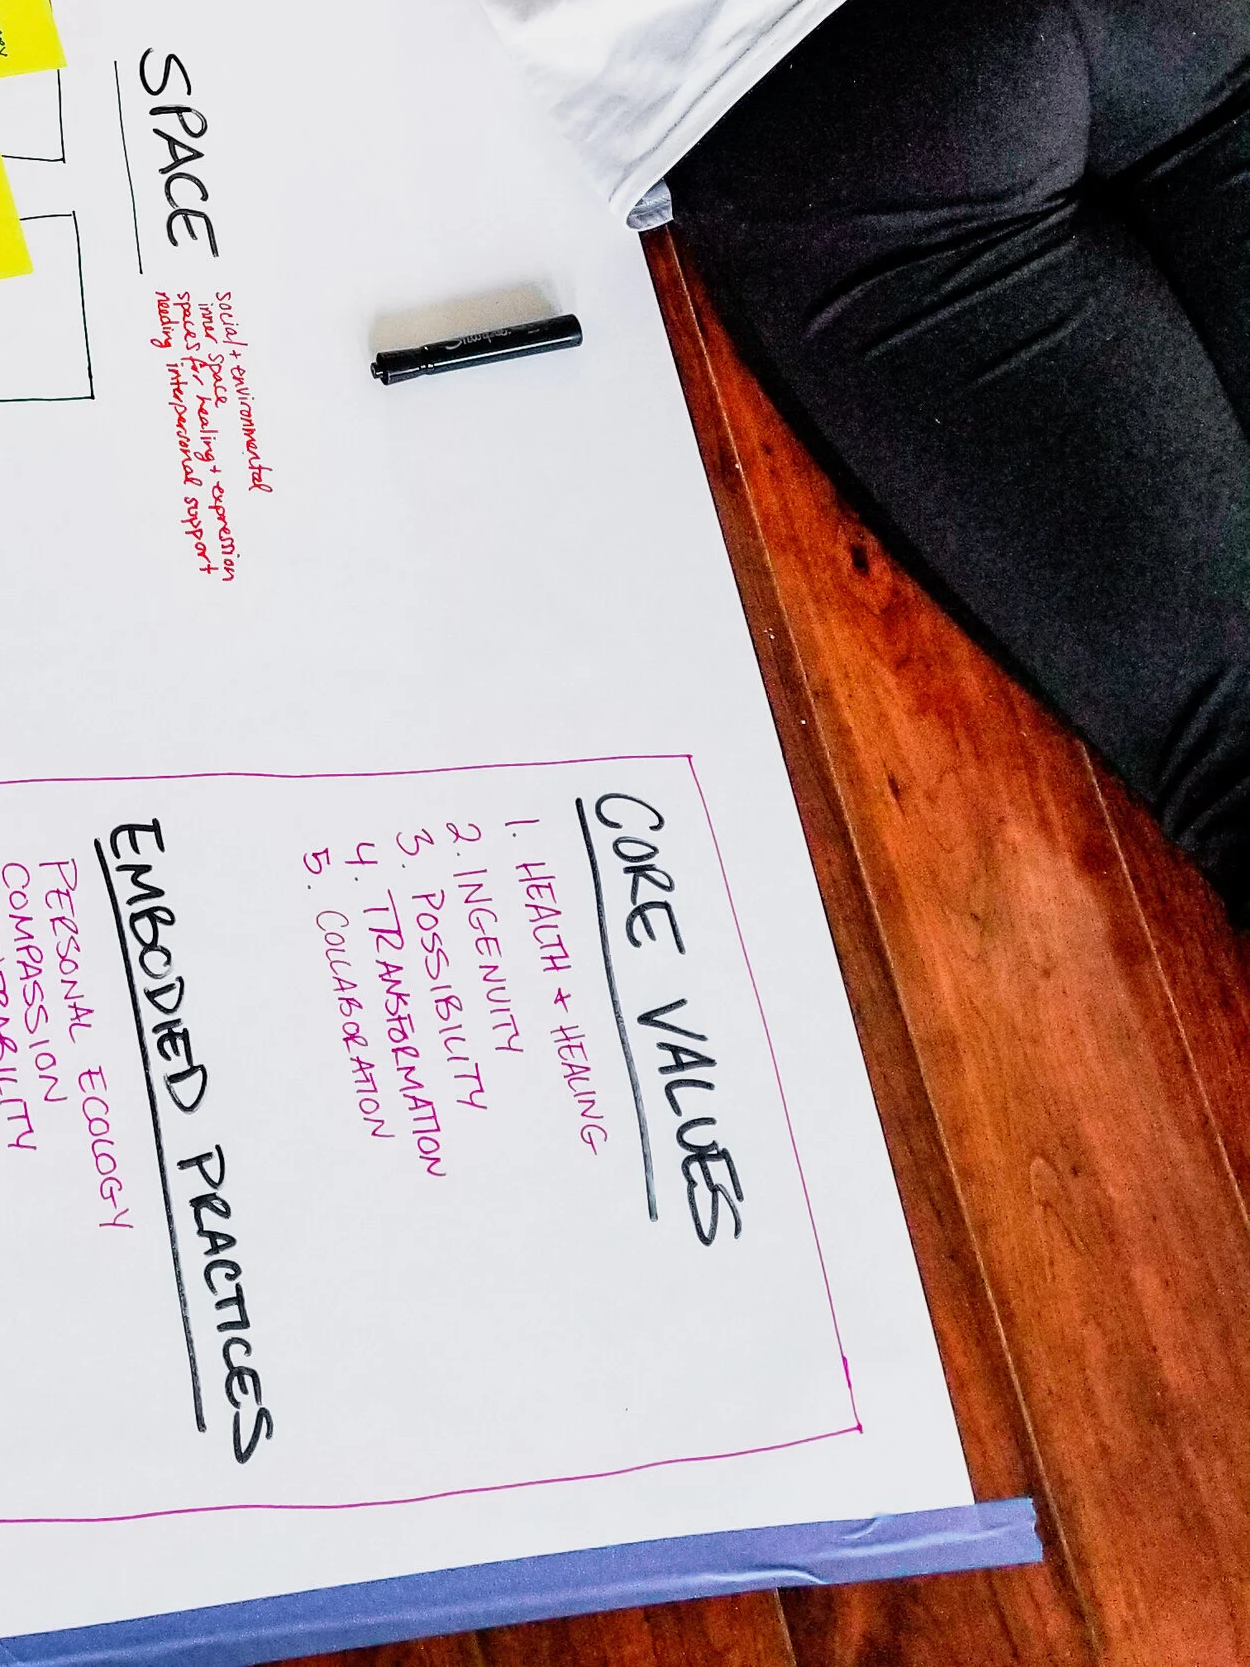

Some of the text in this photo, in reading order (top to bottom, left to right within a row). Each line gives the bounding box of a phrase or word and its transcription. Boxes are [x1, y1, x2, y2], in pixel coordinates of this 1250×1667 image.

[137, 47, 219, 258] SPACE
[172, 291, 201, 352] spaces
[180, 356, 207, 386] for
[196, 303, 227, 408] inner space
[214, 291, 247, 347] social
[148, 291, 218, 575] needing interpersonal support
[193, 395, 218, 462] healing
[229, 365, 272, 493] environmental
[207, 481, 240, 582] expression
[503, 818, 540, 838] 1.
[1, 862, 66, 1103] COMPASSION
[302, 847, 394, 1140] 5. COLLABORATION
[394, 828, 486, 1111] 3. POSSIBILITY
[444, 822, 523, 1054] 2. INGENUITY
[514, 862, 571, 973] HEALTH
[39, 857, 132, 1231] PERSONAL ECOLOGY
[342, 841, 445, 1177] 4. TRANSFORMATION
[549, 1025, 607, 1156] HEALING
[594, 792, 744, 1246] CORE VALUES
[108, 817, 273, 1465] EMBODIED PRACTICES
